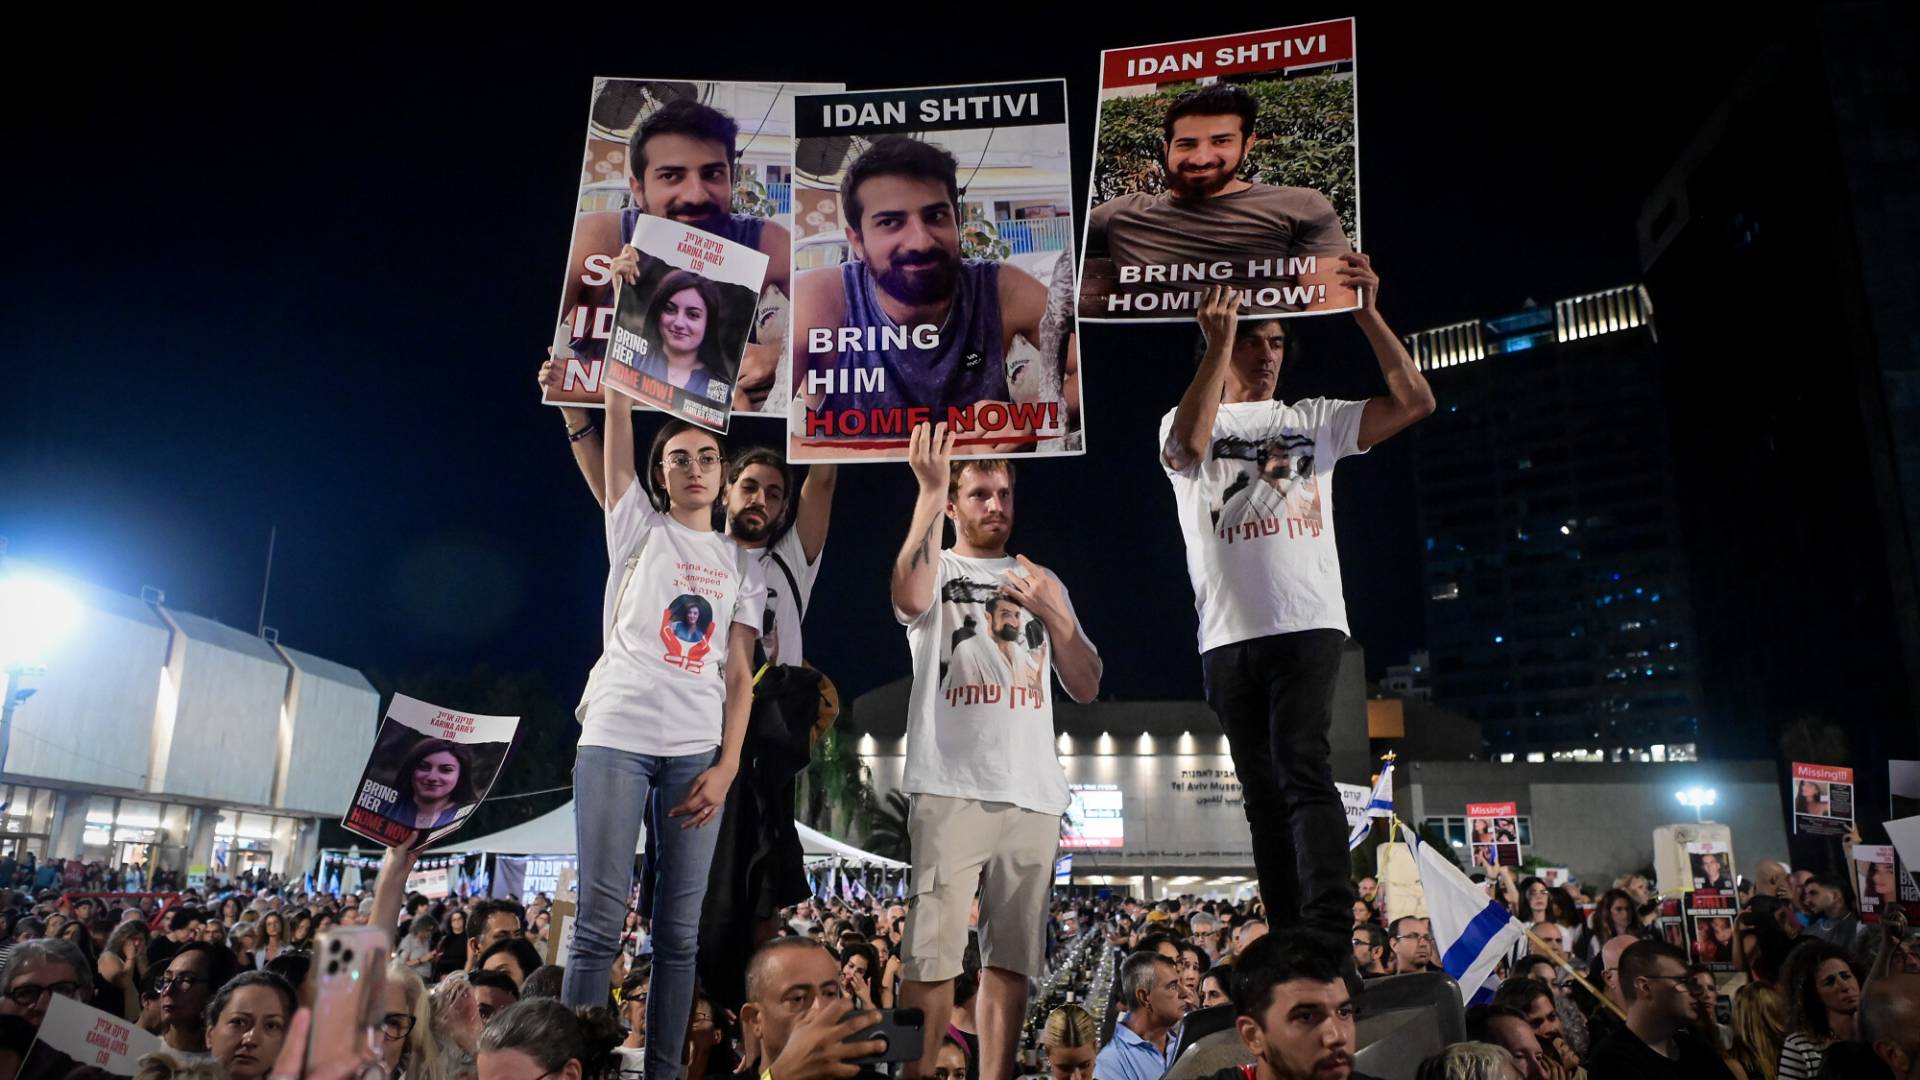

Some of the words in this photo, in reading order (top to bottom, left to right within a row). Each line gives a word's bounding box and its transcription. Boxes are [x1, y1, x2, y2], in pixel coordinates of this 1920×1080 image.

[1127, 51, 1203, 78] IDAN
[1215, 35, 1327, 67] SHTIVI
[823, 100, 906, 128] IDAN
[919, 93, 1039, 122] SHTIVI
[677, 242, 703, 260] KARINA
[703, 251, 725, 266] ARIEV
[690, 258, 704, 273] (19)
[581, 254, 612, 286] S
[1119, 260, 1234, 285] BRING
[1247, 255, 1317, 279] HIM
[572, 305, 617, 339] ID
[614, 326, 649, 356] BRING
[808, 323, 941, 354] BRING
[611, 341, 634, 367] HER
[562, 359, 603, 393] N
[607, 360, 641, 389] HOME
[641, 375, 674, 403] NOW!
[807, 366, 886, 395] HIM
[805, 407, 930, 437] HOME
[946, 402, 1060, 434] NOW!
[1220, 518, 1281, 545] שתיוי
[1286, 517, 1321, 540] עידן
[945, 684, 1002, 708] שתיוי
[1009, 685, 1043, 710] עידן
[430, 717, 455, 730] KARINA
[455, 723, 475, 734] ARIEV
[1172, 781, 1185, 793] Tel
[1188, 781, 1208, 793] Aviv
[1210, 781, 1243, 793] Museu
[1798, 766, 1847, 781] Missing!!!
[356, 791, 382, 813] HER
[362, 778, 399, 804] BRING
[350, 806, 385, 834] HOME
[85, 1030, 112, 1050] KARINA
